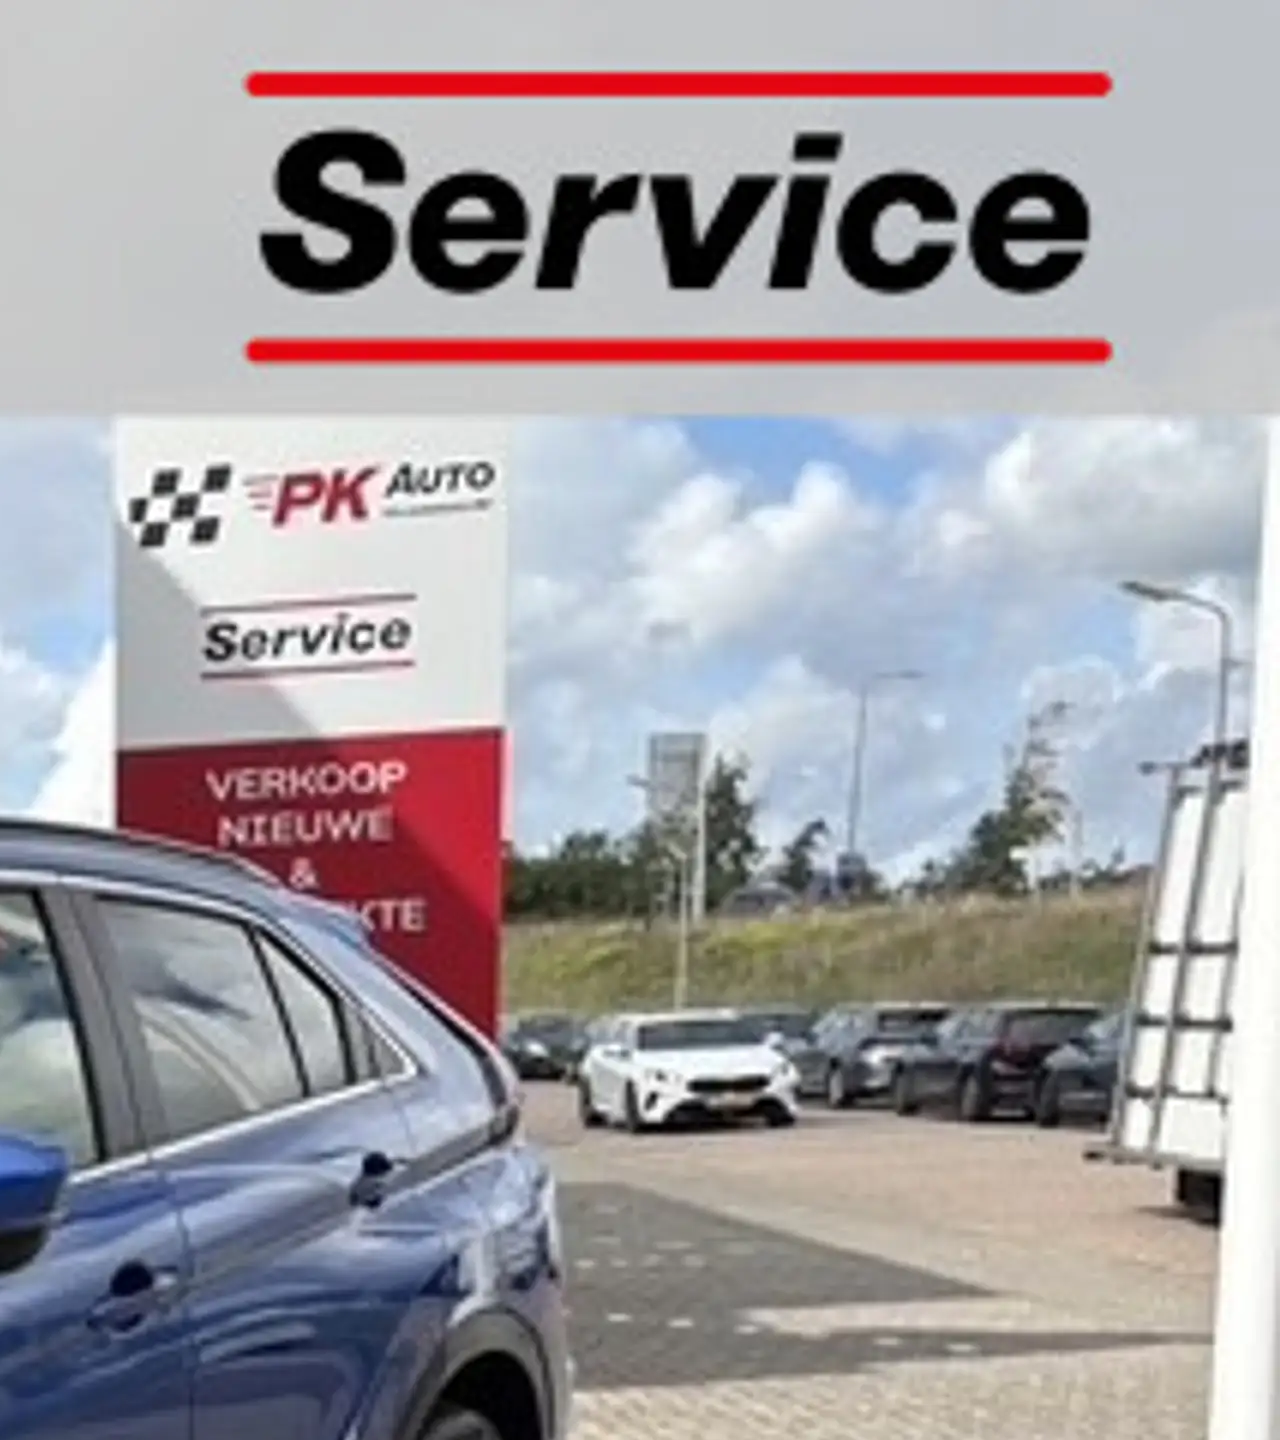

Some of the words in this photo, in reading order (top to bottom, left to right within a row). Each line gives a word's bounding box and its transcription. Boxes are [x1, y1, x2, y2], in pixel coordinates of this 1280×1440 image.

[272, 466, 378, 526] PK
[201, 612, 412, 663] Service
[206, 762, 406, 800] VERKOOP
[217, 807, 393, 846] NIEUWE
[288, 857, 317, 888] &
